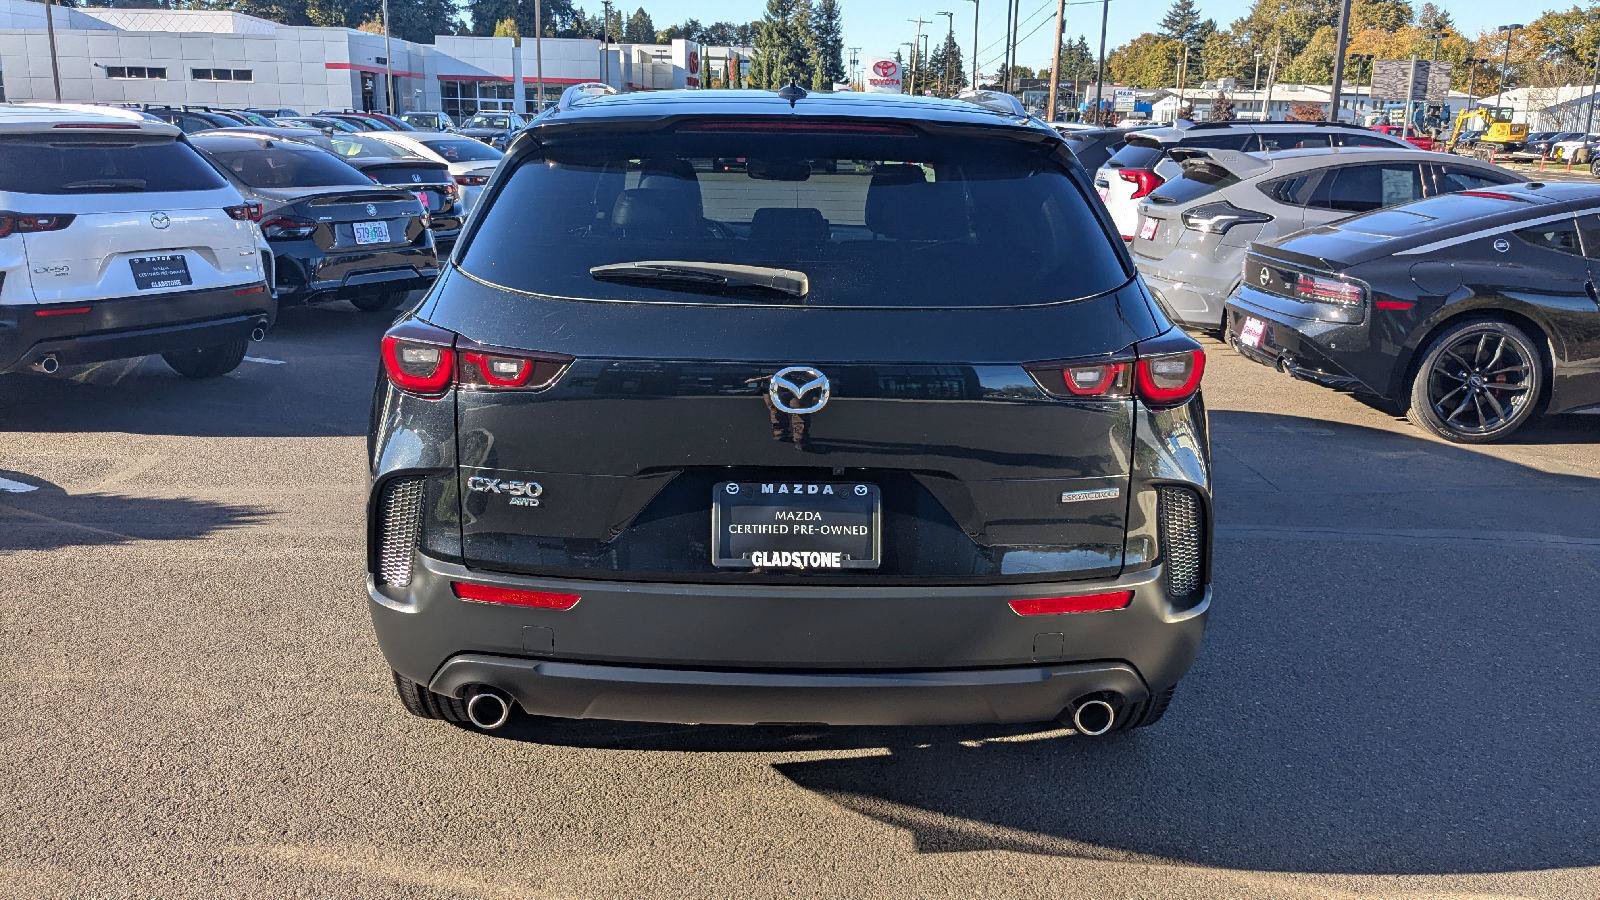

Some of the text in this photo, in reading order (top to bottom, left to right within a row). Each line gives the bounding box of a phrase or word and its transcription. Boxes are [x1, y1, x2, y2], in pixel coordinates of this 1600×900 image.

[467, 476, 543, 498] CX-50
[761, 483, 834, 495] MAZDA
[509, 497, 540, 507] AWD
[775, 511, 822, 521] MAZDA
[728, 524, 868, 536] CERTIFIED PRE-OWNED
[751, 551, 841, 568] GLADSTONE
